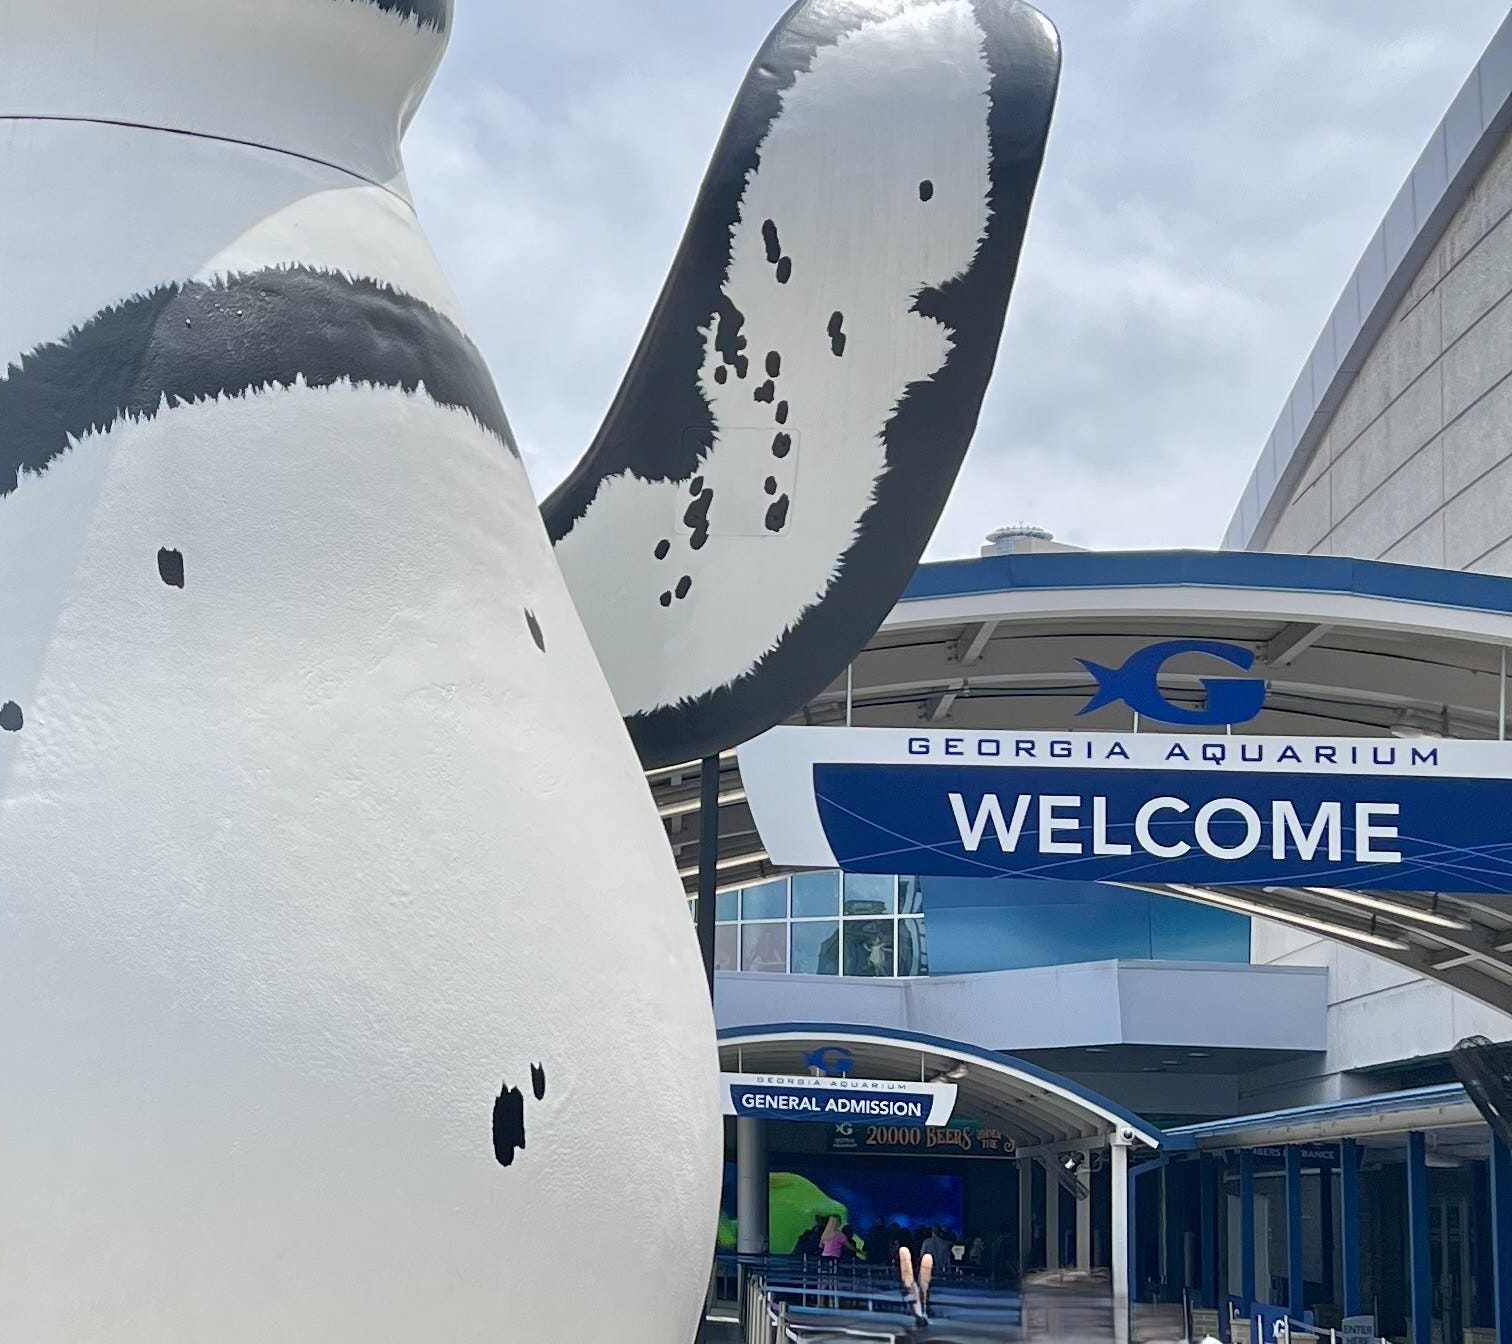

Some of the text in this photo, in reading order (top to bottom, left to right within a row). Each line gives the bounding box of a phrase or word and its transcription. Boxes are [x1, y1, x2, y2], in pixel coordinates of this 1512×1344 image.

[907, 737, 1439, 766] GEORGIA AQUARIUM
[947, 792, 1403, 864] WELCOME
[756, 1076, 907, 1090] GEORGIA AQUARIUM
[741, 1093, 923, 1117] GENERAL ADMISSION
[865, 1125, 921, 1145] 20000
[926, 1126, 972, 1151] BEERS
[1343, 1324, 1373, 1335] ENTER
